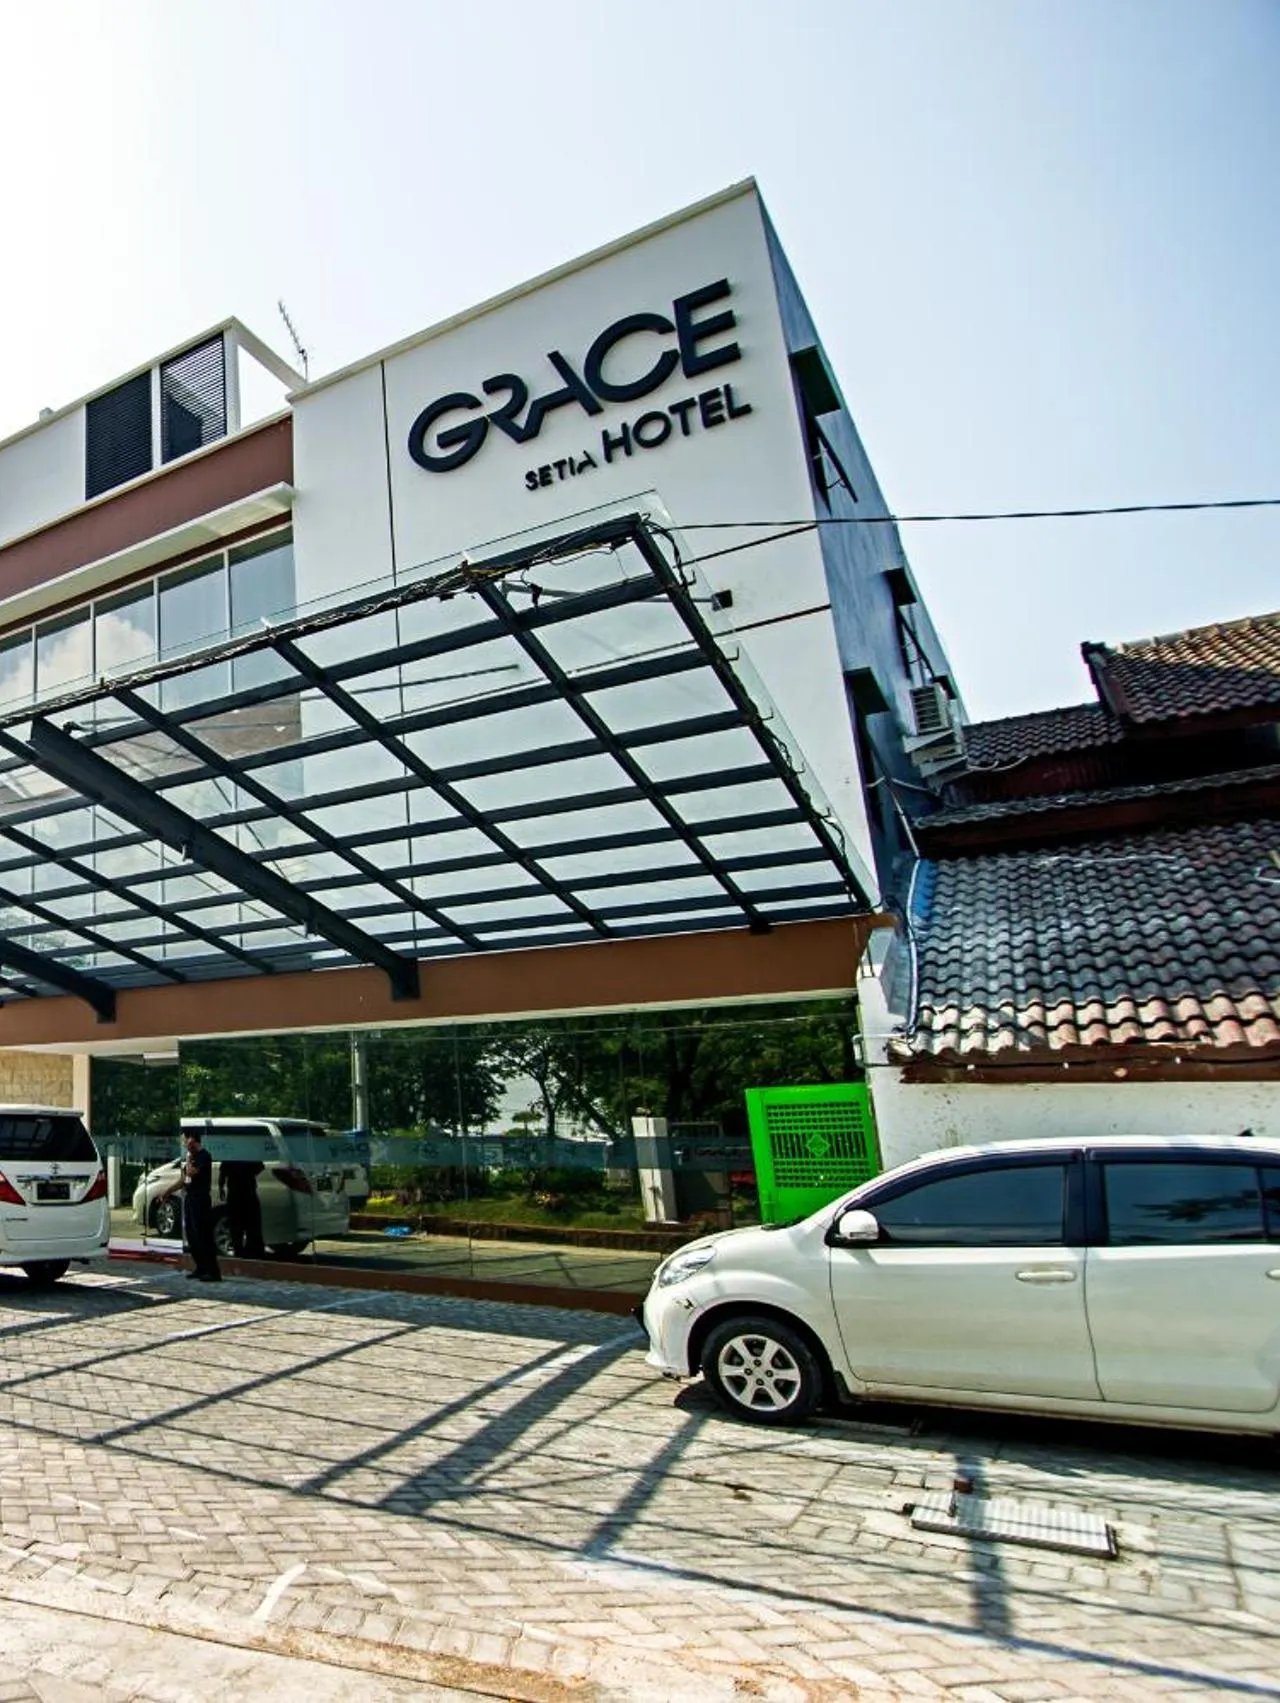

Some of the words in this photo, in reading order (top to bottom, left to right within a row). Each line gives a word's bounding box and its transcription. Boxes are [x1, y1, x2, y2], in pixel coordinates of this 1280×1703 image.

[407, 277, 742, 473] GRACE
[525, 450, 598, 492] SETIA
[601, 383, 753, 464] HOTEL
